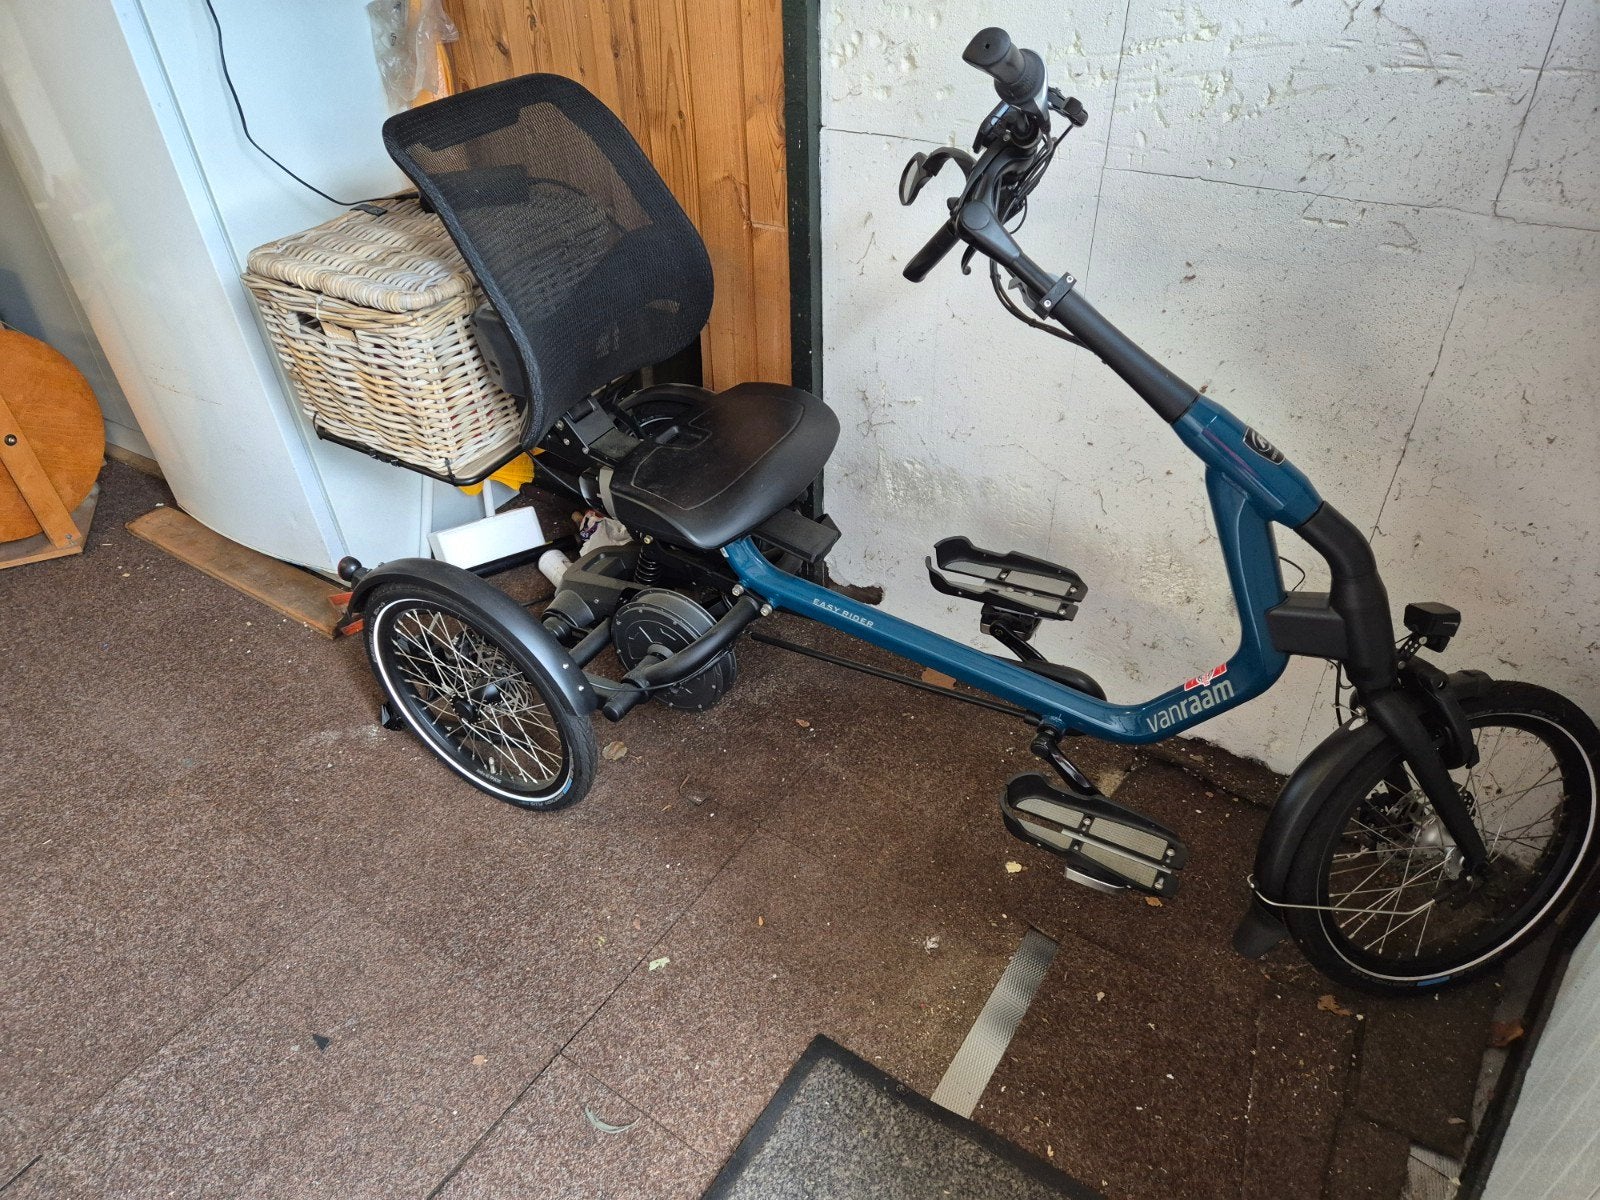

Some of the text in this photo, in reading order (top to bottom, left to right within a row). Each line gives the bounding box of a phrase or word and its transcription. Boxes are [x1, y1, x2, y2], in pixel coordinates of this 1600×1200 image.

[813, 598, 874, 628] EASY RIDER
[1146, 679, 1235, 733] vanraam
